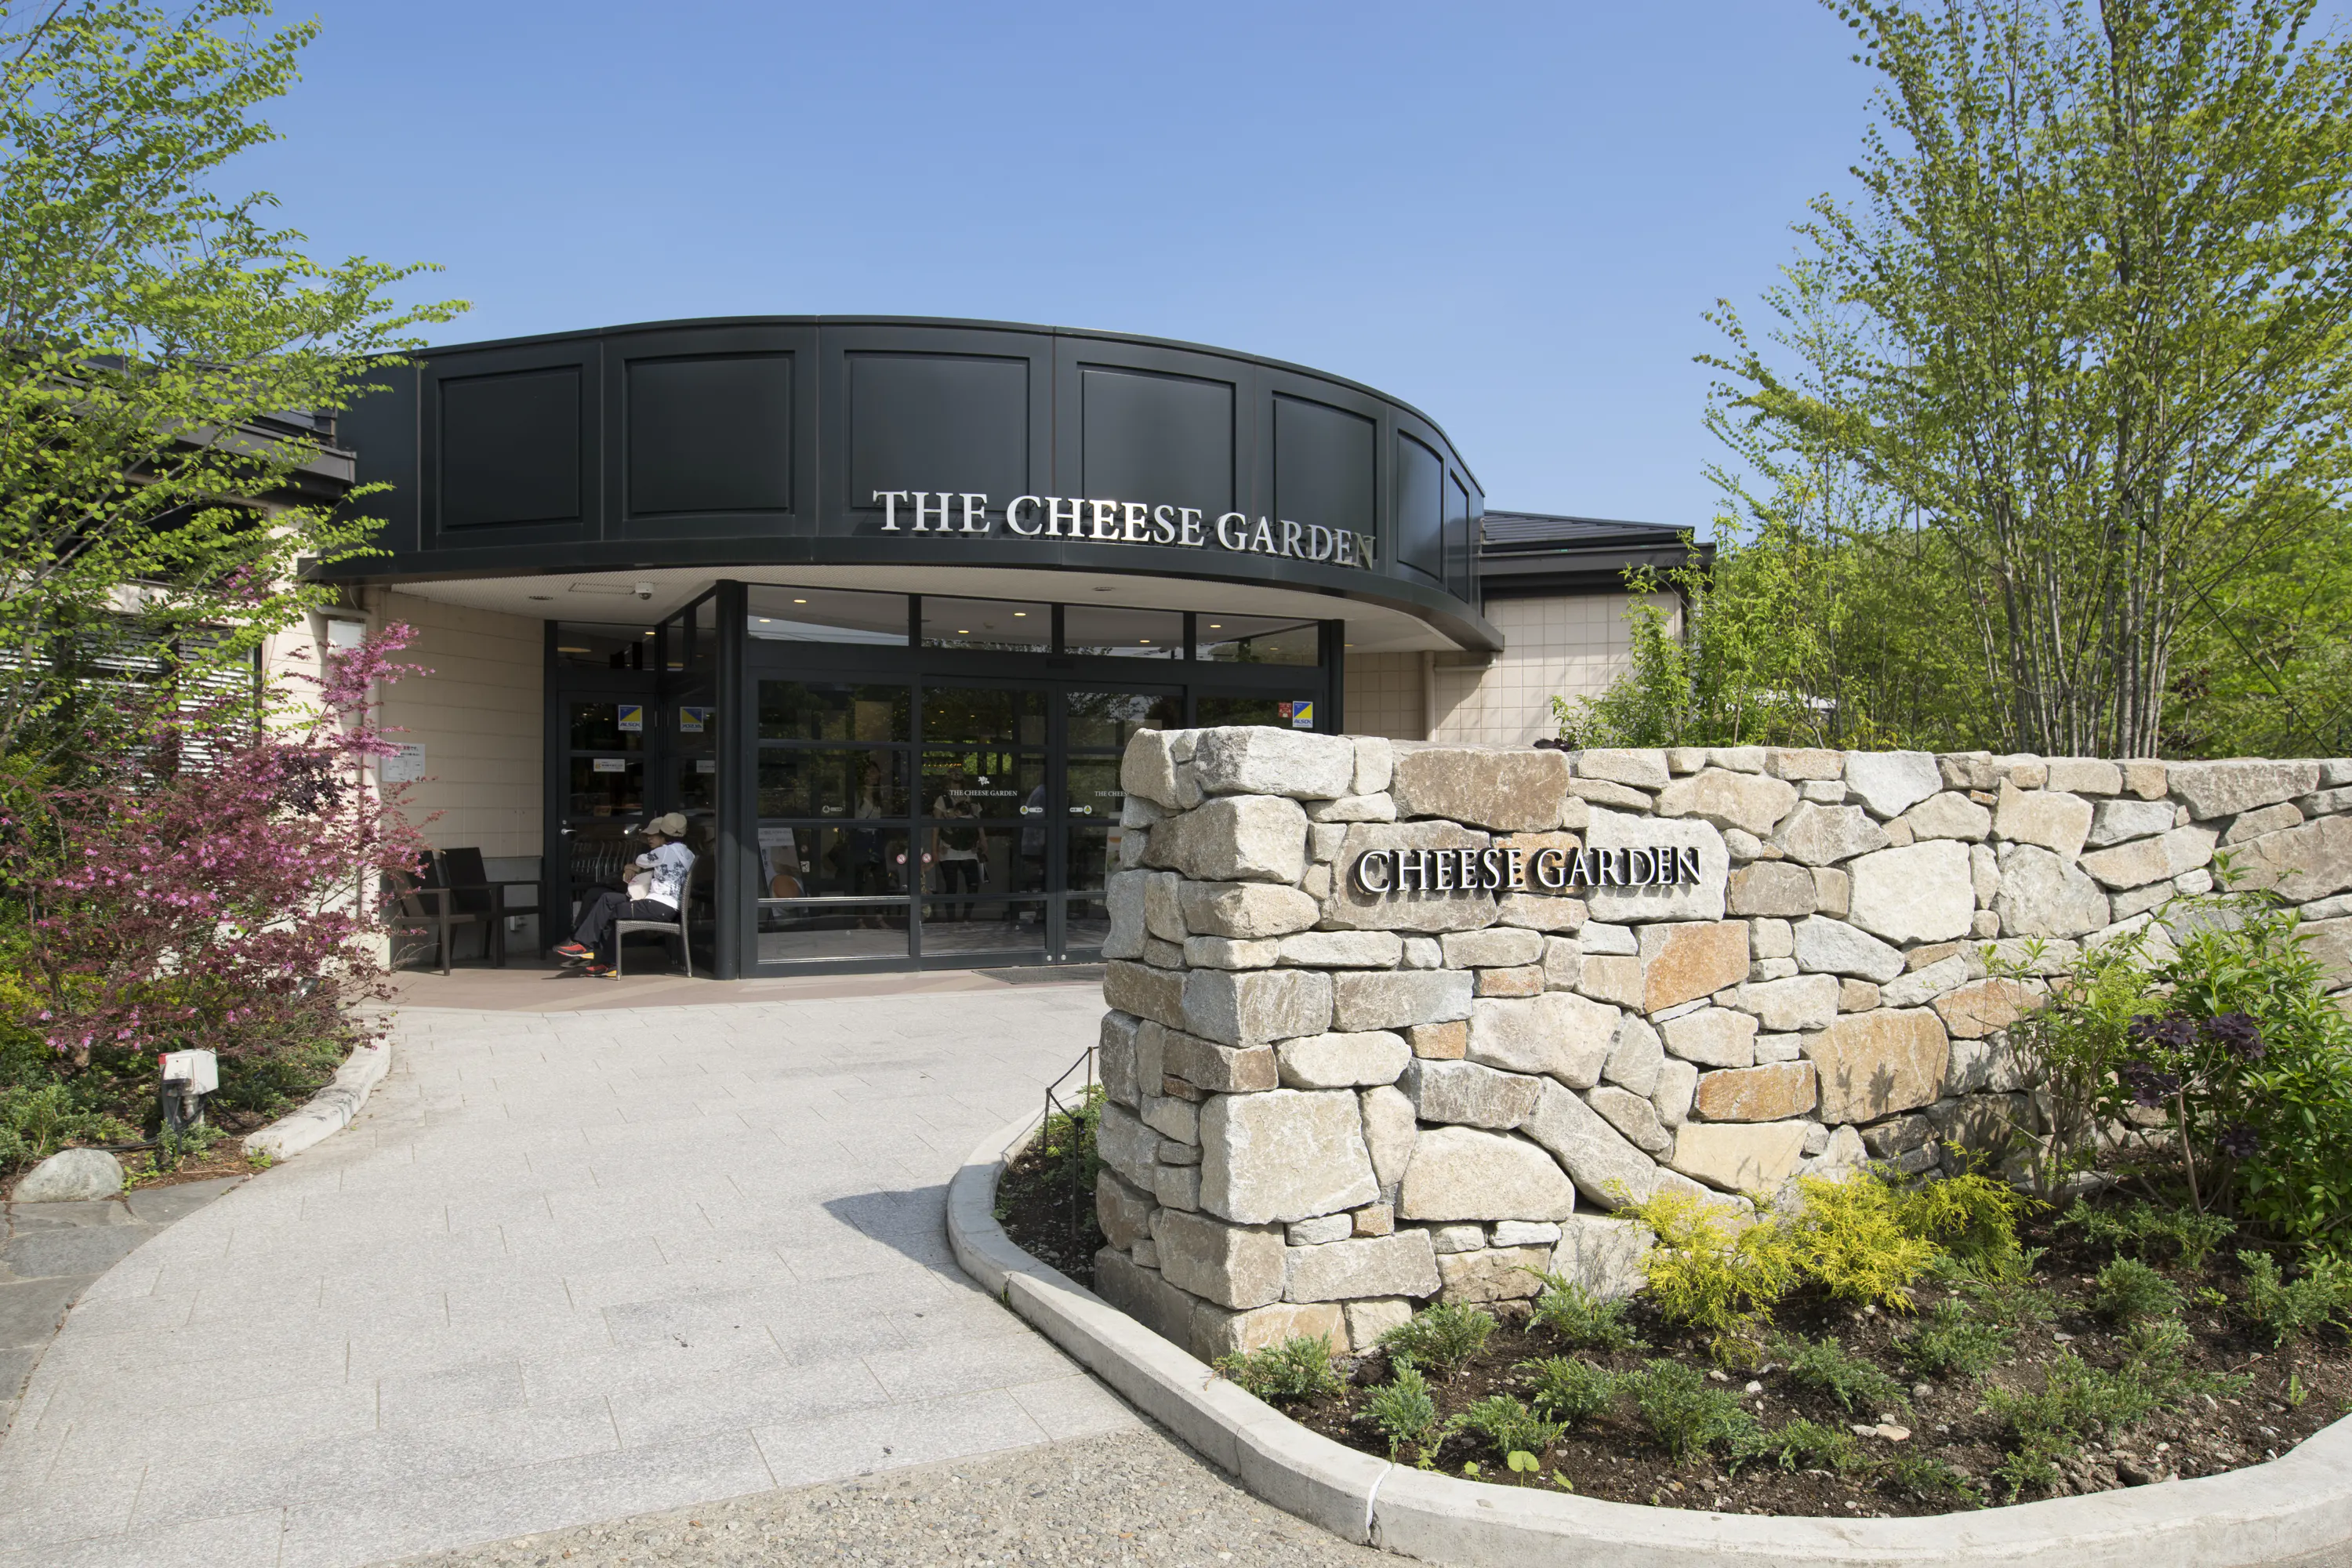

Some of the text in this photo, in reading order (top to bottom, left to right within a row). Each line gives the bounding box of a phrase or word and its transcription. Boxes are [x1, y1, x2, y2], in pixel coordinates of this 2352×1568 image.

[873, 490, 1376, 570] THE CHEESE GARDEN
[1356, 847, 1702, 893] CHEESE GARDEN
